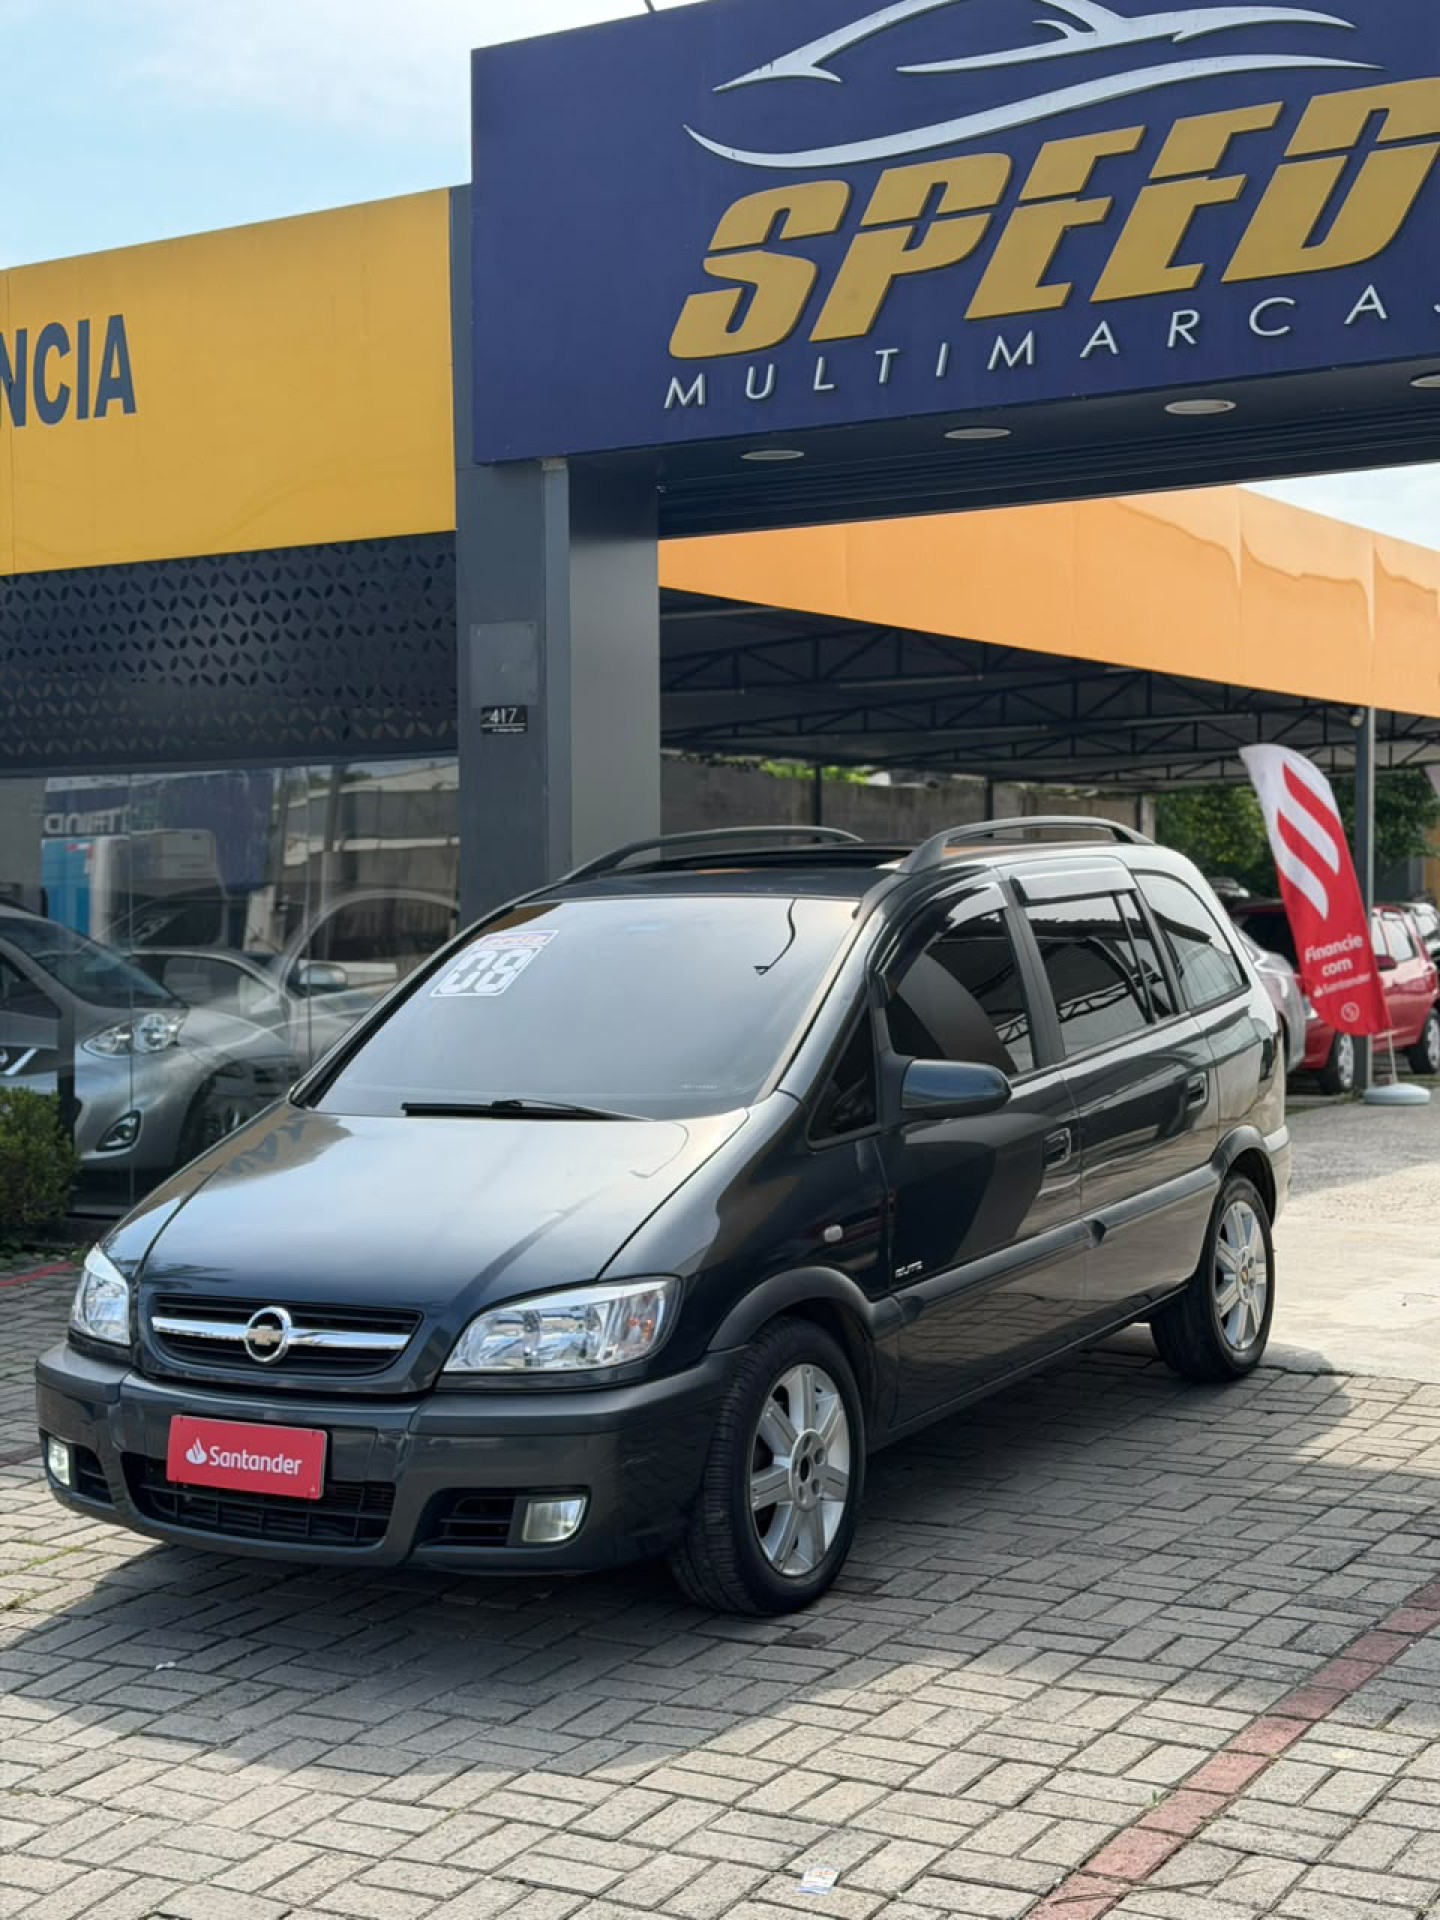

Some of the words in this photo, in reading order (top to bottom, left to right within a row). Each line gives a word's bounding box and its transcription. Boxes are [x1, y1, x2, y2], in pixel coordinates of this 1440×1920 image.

[669, 77, 1440, 359] SPEED
[664, 284, 1440, 408] MULTIMARCA
[490, 707, 517, 724] 417
[1304, 933, 1363, 964] Financie
[440, 949, 534, 994] 08
[1322, 959, 1353, 977] com
[208, 1445, 303, 1476] Santander
